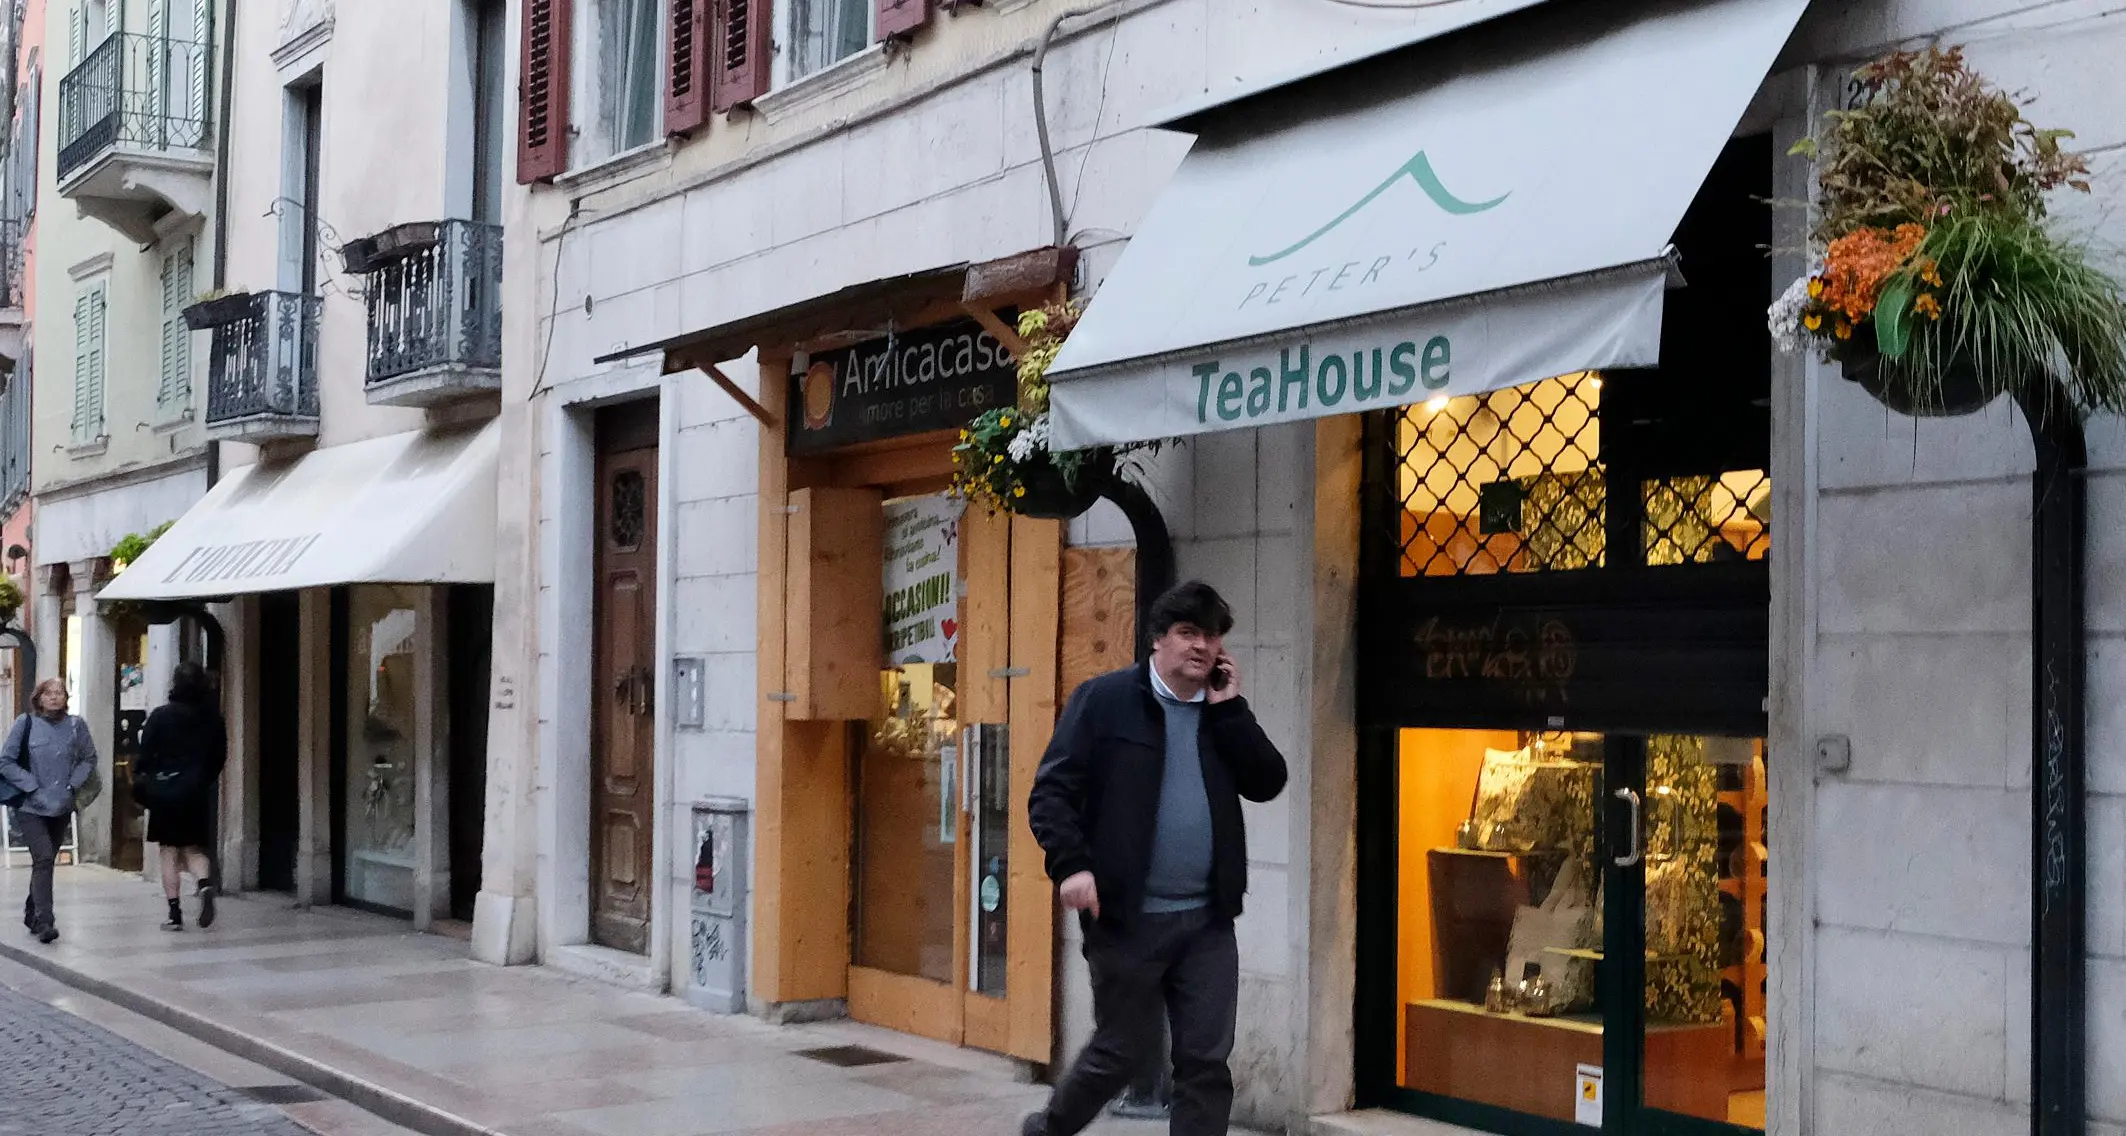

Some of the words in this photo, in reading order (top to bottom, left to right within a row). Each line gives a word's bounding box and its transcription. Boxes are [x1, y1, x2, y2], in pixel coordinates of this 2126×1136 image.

[1238, 241, 1447, 310] PETER'S
[909, 393, 935, 418] per
[939, 386, 952, 411] la
[1192, 335, 1451, 423] TeaHouse
[161, 533, 323, 583] L'OFFICINA
